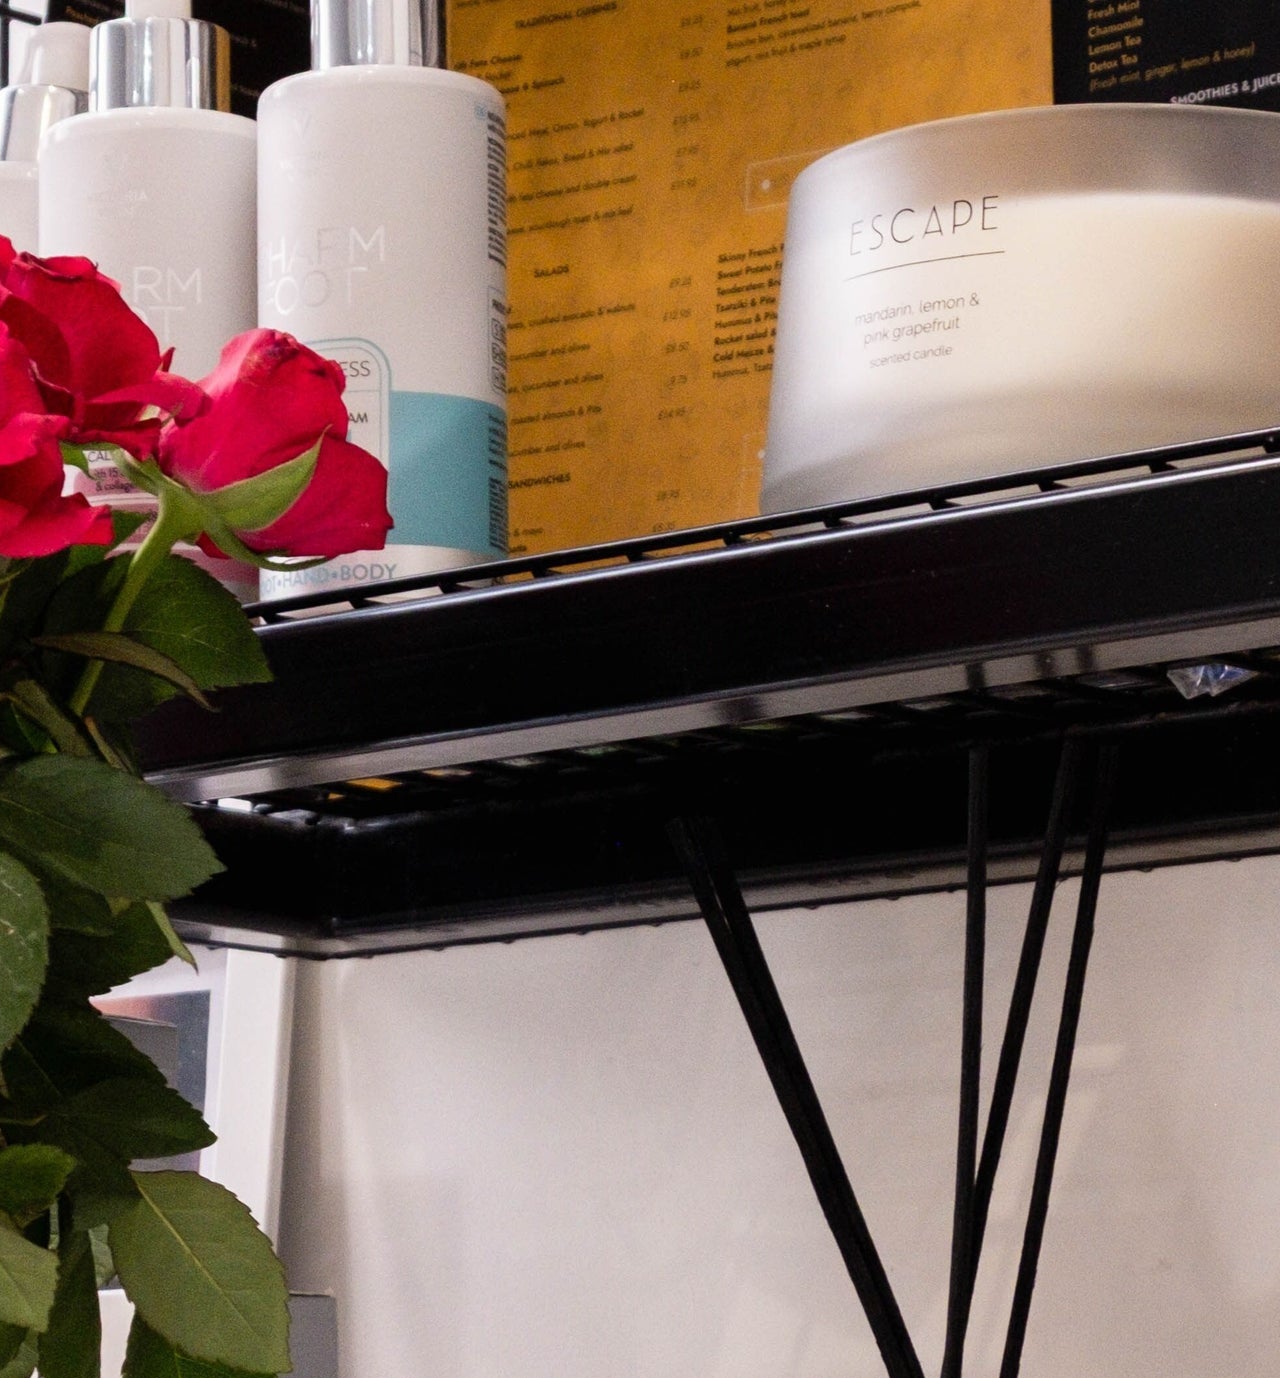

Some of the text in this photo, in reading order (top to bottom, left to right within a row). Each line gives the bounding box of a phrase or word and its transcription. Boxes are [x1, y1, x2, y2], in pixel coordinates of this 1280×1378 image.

[1088, 16, 1144, 38] Chamomile
[1088, 36, 1142, 56] Lemon Tea
[1213, 51, 1221, 62] &
[1089, 54, 1138, 74] Detox Tea
[1170, 82, 1239, 104] SMOOTHIES
[1241, 79, 1250, 91] &
[849, 195, 1000, 257] ESCAPE
[919, 295, 965, 314] lemon
[969, 292, 980, 307] &
[863, 316, 961, 347] pink grapefruit
[869, 344, 953, 369] scented candle
[340, 563, 398, 582] BODY
